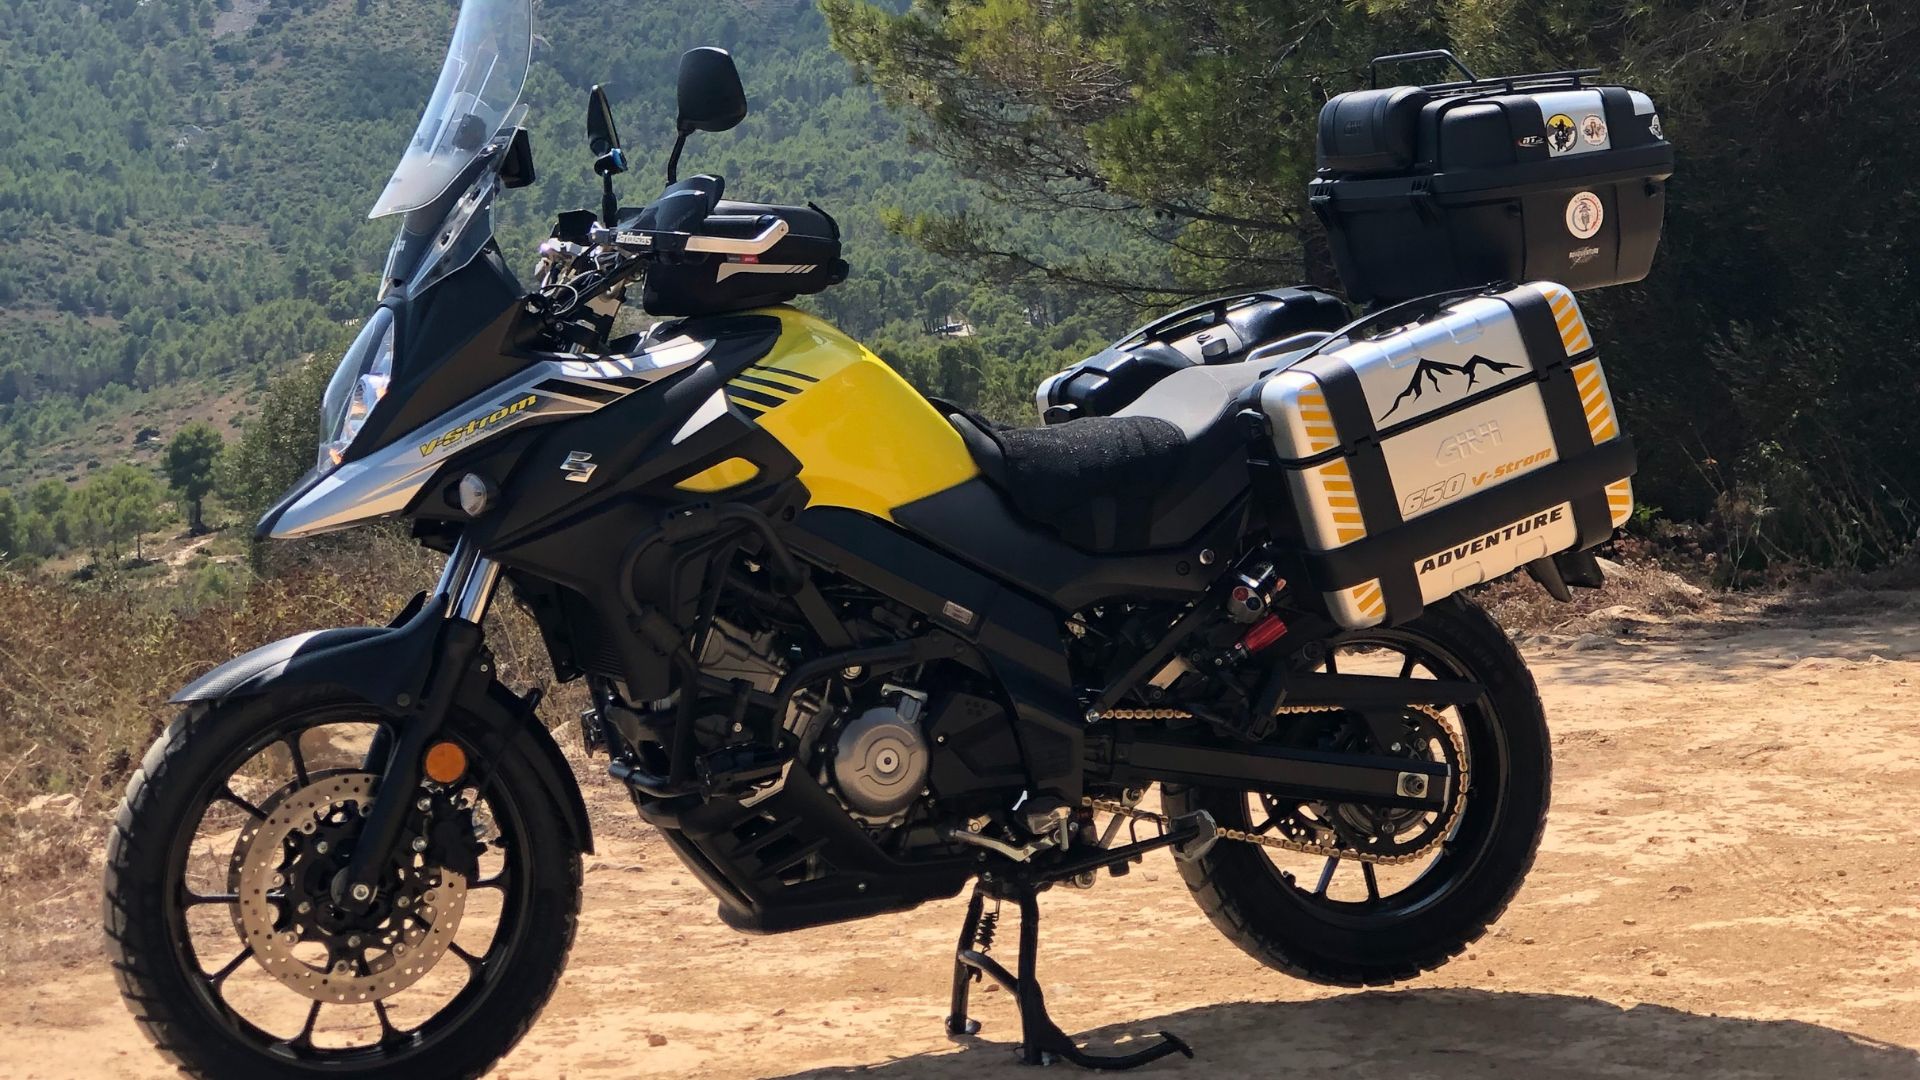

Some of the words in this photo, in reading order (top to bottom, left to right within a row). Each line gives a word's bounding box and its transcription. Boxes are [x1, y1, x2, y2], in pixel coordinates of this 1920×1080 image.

[419, 393, 538, 458] V-Strom
[1401, 472, 1467, 517] 650
[1472, 447, 1552, 486] V-Strom
[1420, 507, 1564, 574] ADVENTURE
